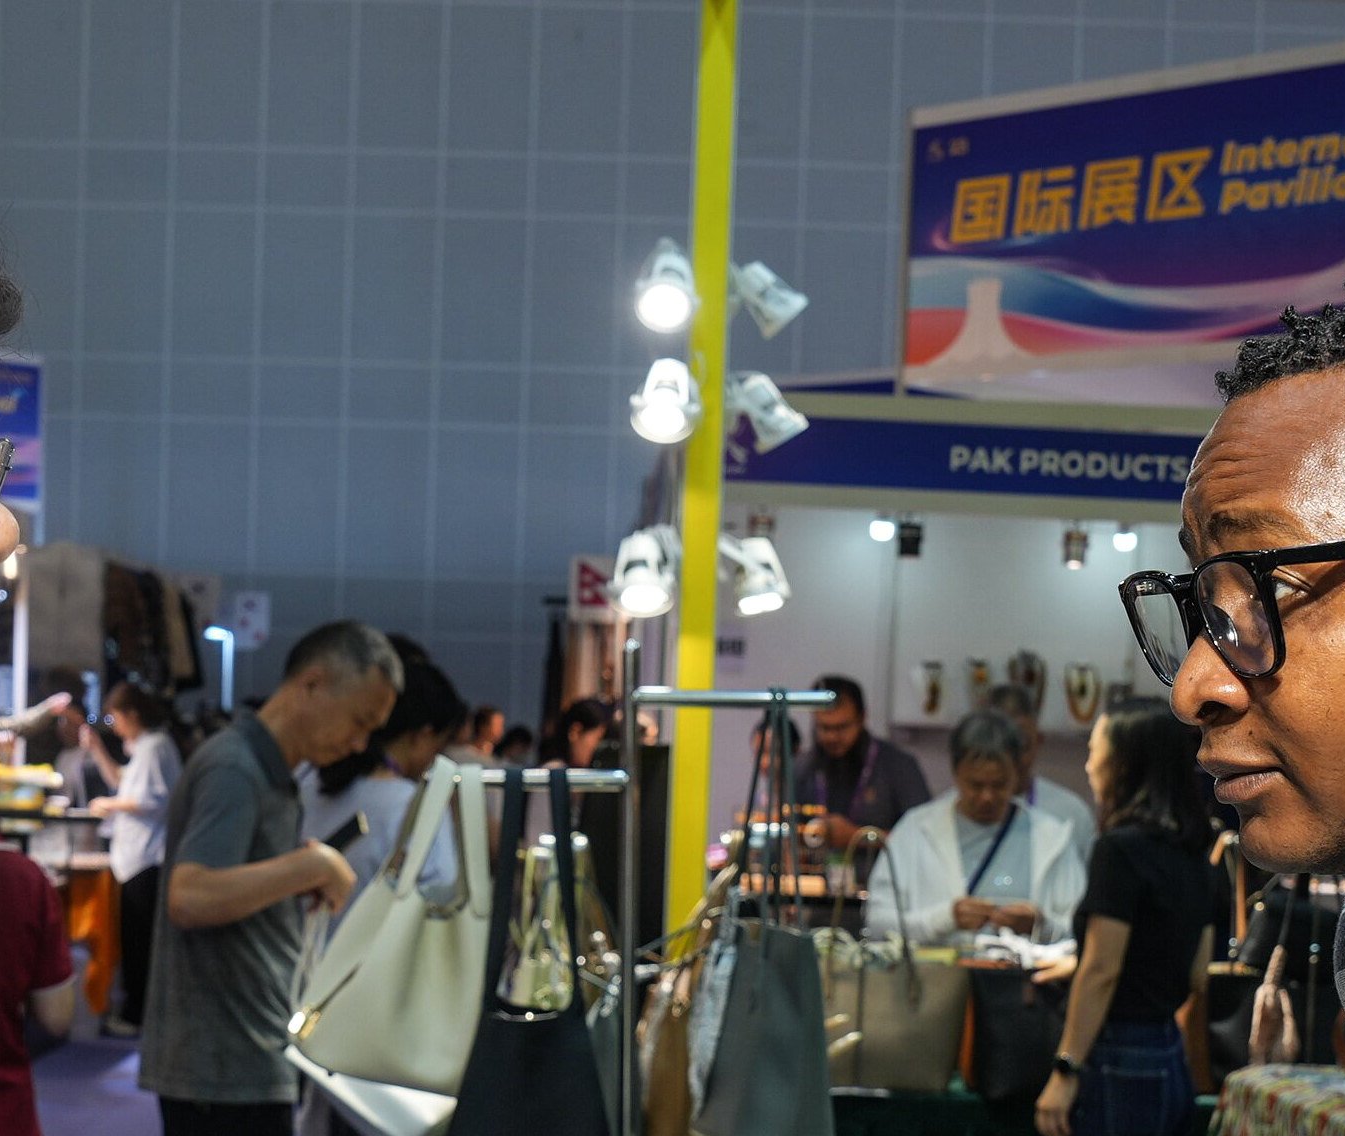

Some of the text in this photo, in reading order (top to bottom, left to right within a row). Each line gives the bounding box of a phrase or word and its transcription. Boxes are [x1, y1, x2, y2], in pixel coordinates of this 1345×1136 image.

[950, 147, 1213, 243] 国际展区
[949, 445, 1189, 483] PAK PRODUCTS
